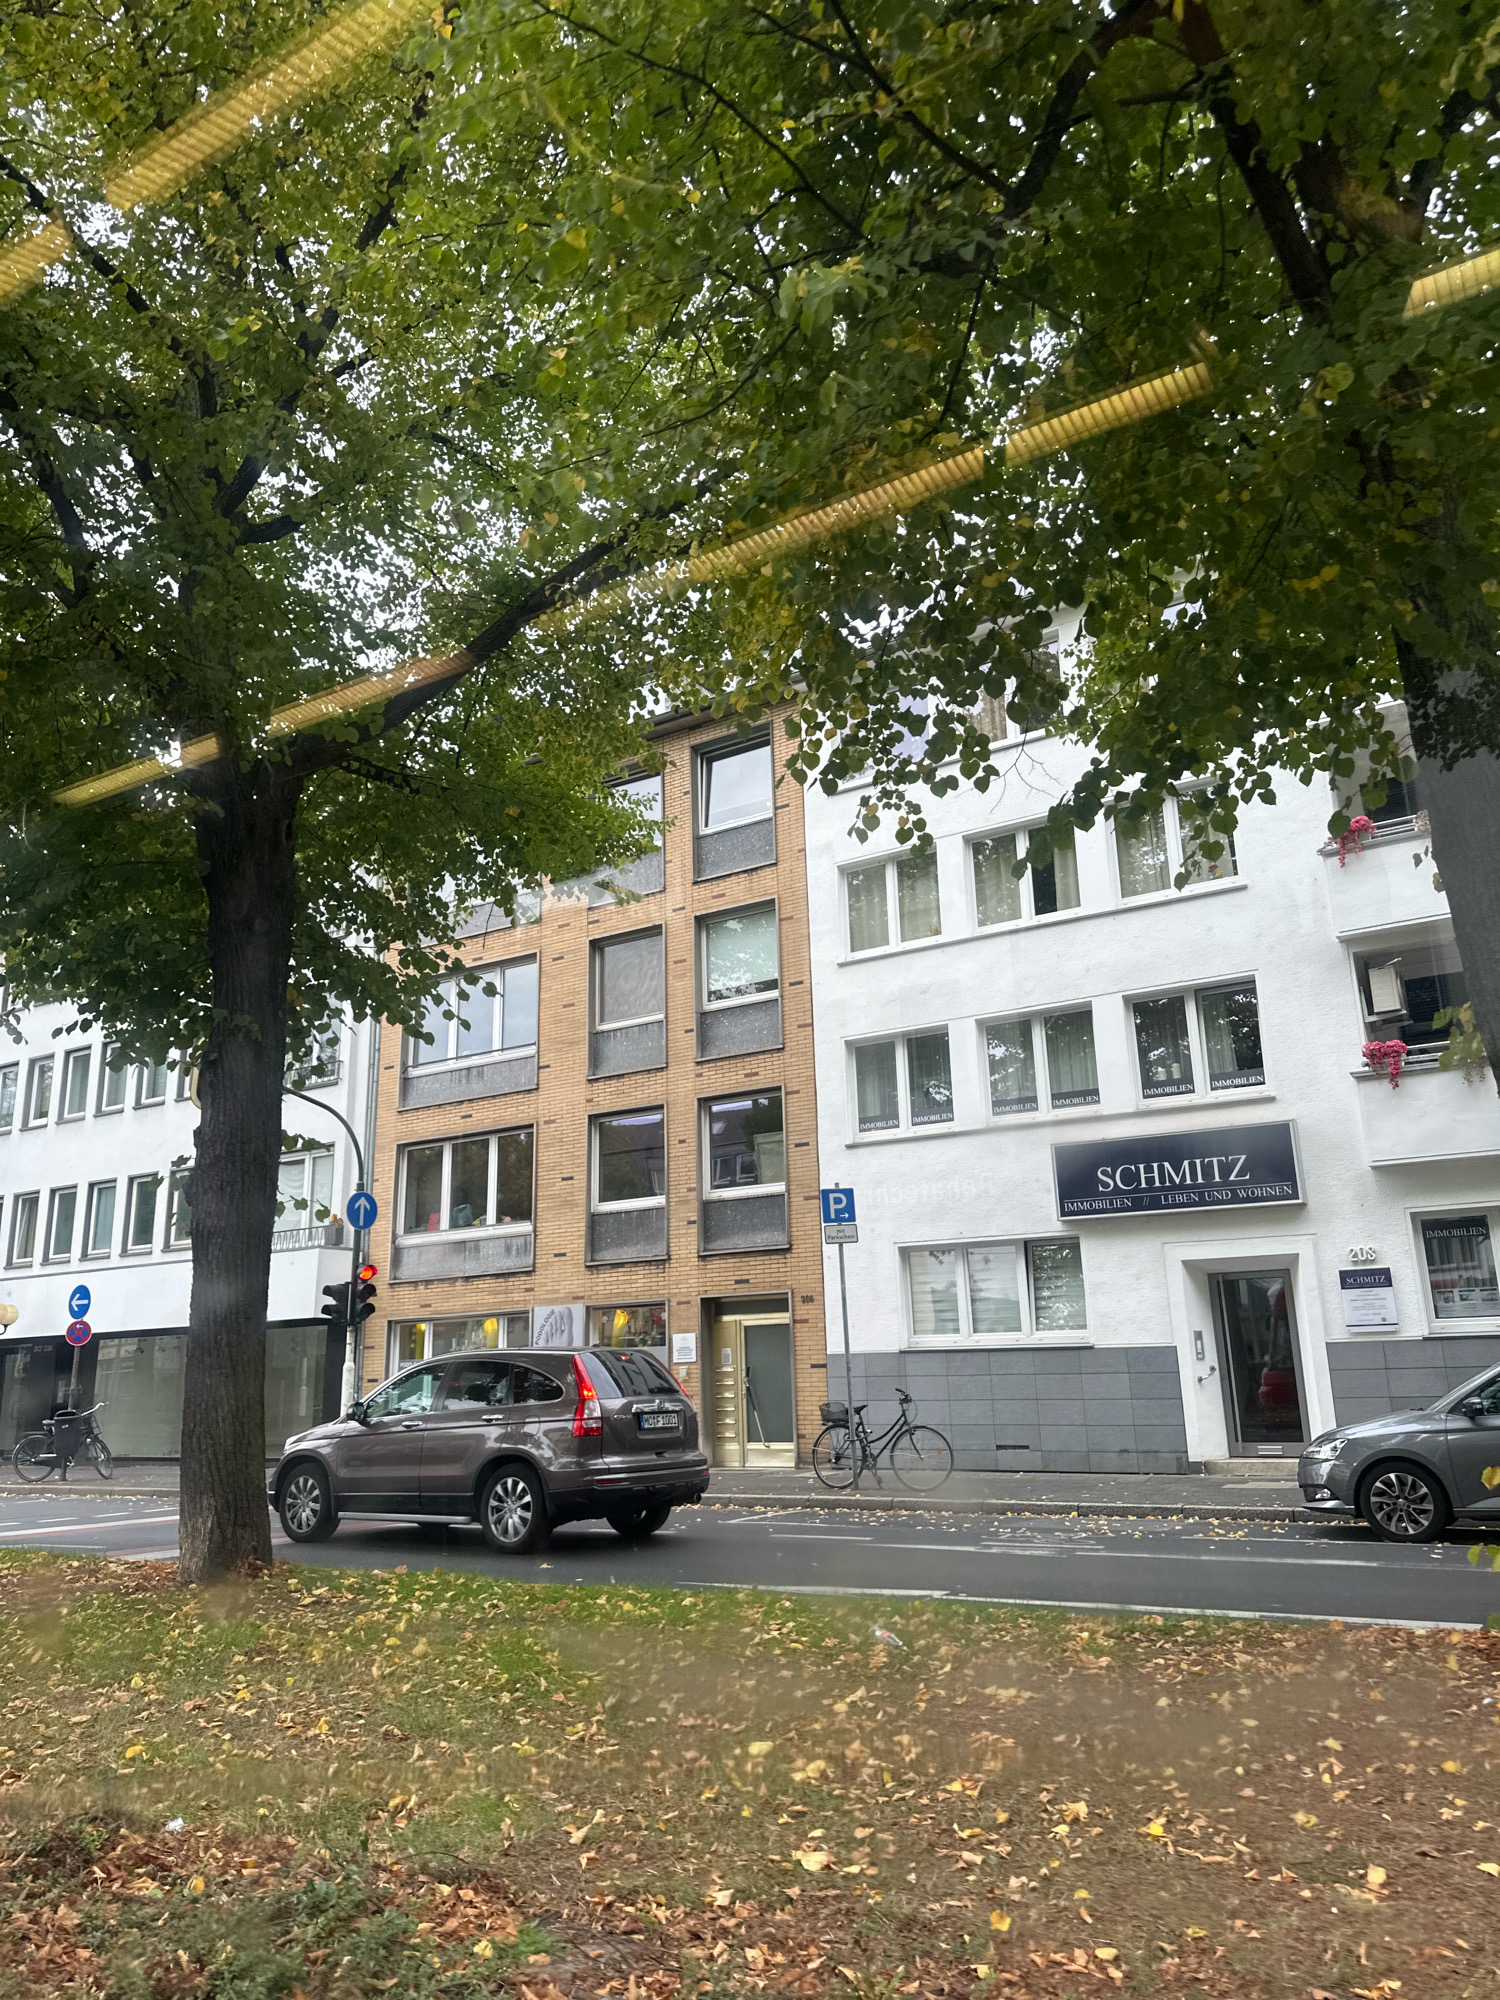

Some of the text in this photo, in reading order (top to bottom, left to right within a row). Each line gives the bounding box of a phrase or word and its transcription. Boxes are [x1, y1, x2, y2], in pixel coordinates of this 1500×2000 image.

[1211, 1075, 1264, 1088] IMMOBILIEN
[1143, 1083, 1194, 1096] IMMOBILIEN
[1053, 1094, 1099, 1107] IMMOBILIEN
[993, 1102, 1037, 1113] IMMOBILIEN
[912, 1112, 953, 1123] IMMOBILIEN
[859, 1119, 899, 1130] IMMOBILIEN
[1097, 1154, 1250, 1192] SCHMITZ
[1064, 1197, 1132, 1212] IMMOBILIEN
[1161, 1192, 1199, 1205] LEBEN
[1205, 1189, 1231, 1201] UND
[1236, 1185, 1292, 1199] WOHNEN
[829, 1192, 847, 1219] P
[1426, 1226, 1487, 1238] IMMOBILIEN
[1349, 1247, 1376, 1262] 208
[1346, 1275, 1386, 1284] SCHMITZ
[535, 1308, 556, 1346] PODOLOGIE
